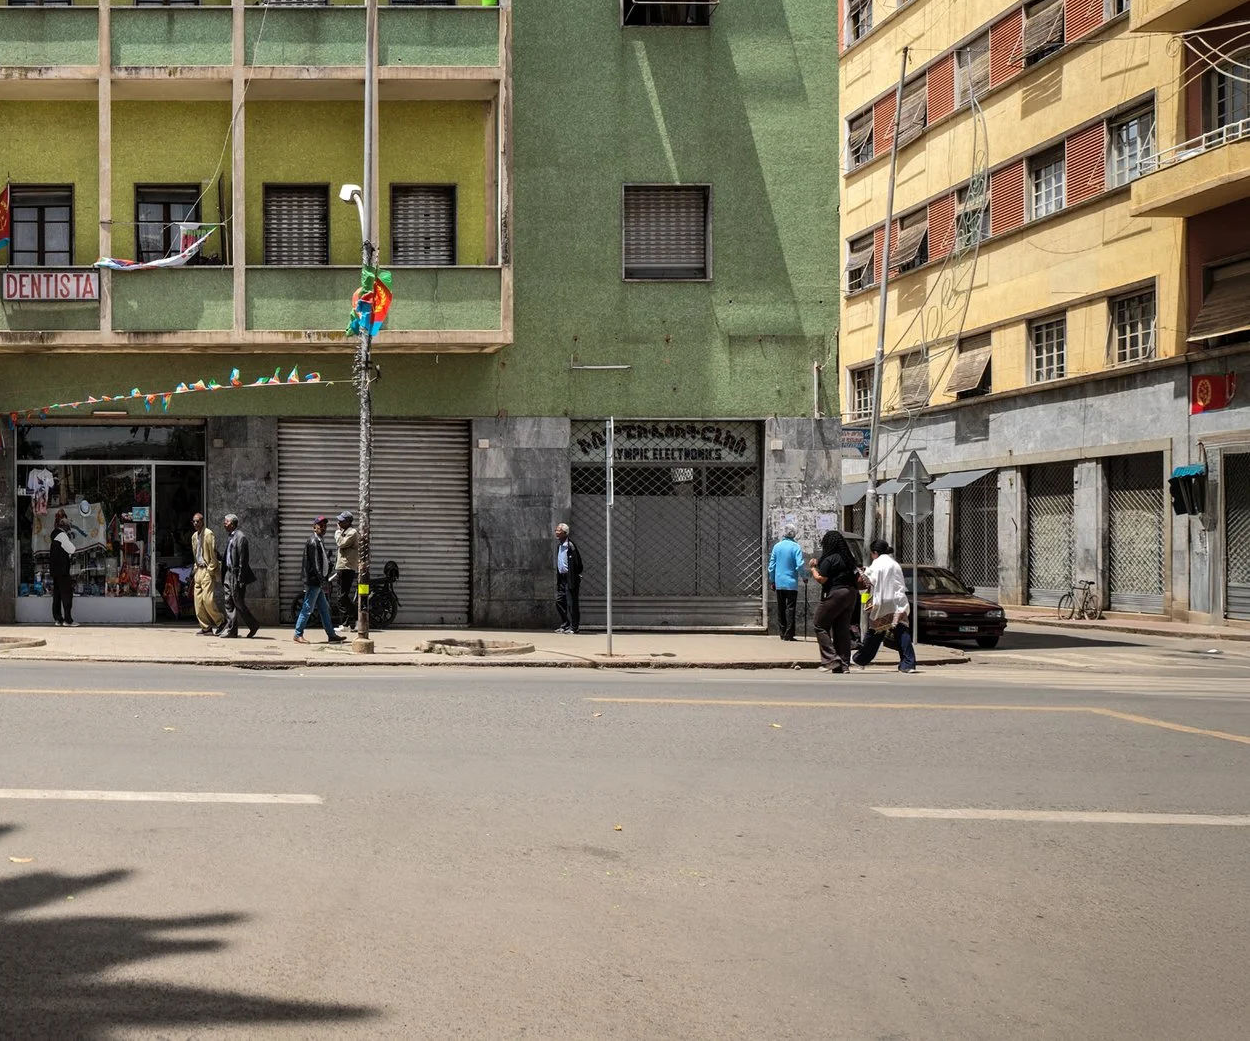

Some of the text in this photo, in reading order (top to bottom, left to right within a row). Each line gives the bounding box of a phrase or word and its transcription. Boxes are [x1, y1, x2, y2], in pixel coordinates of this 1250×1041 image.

[6, 274, 95, 298] DENTISTA
[613, 447, 722, 460] LYMPIC ELECTRONICS
